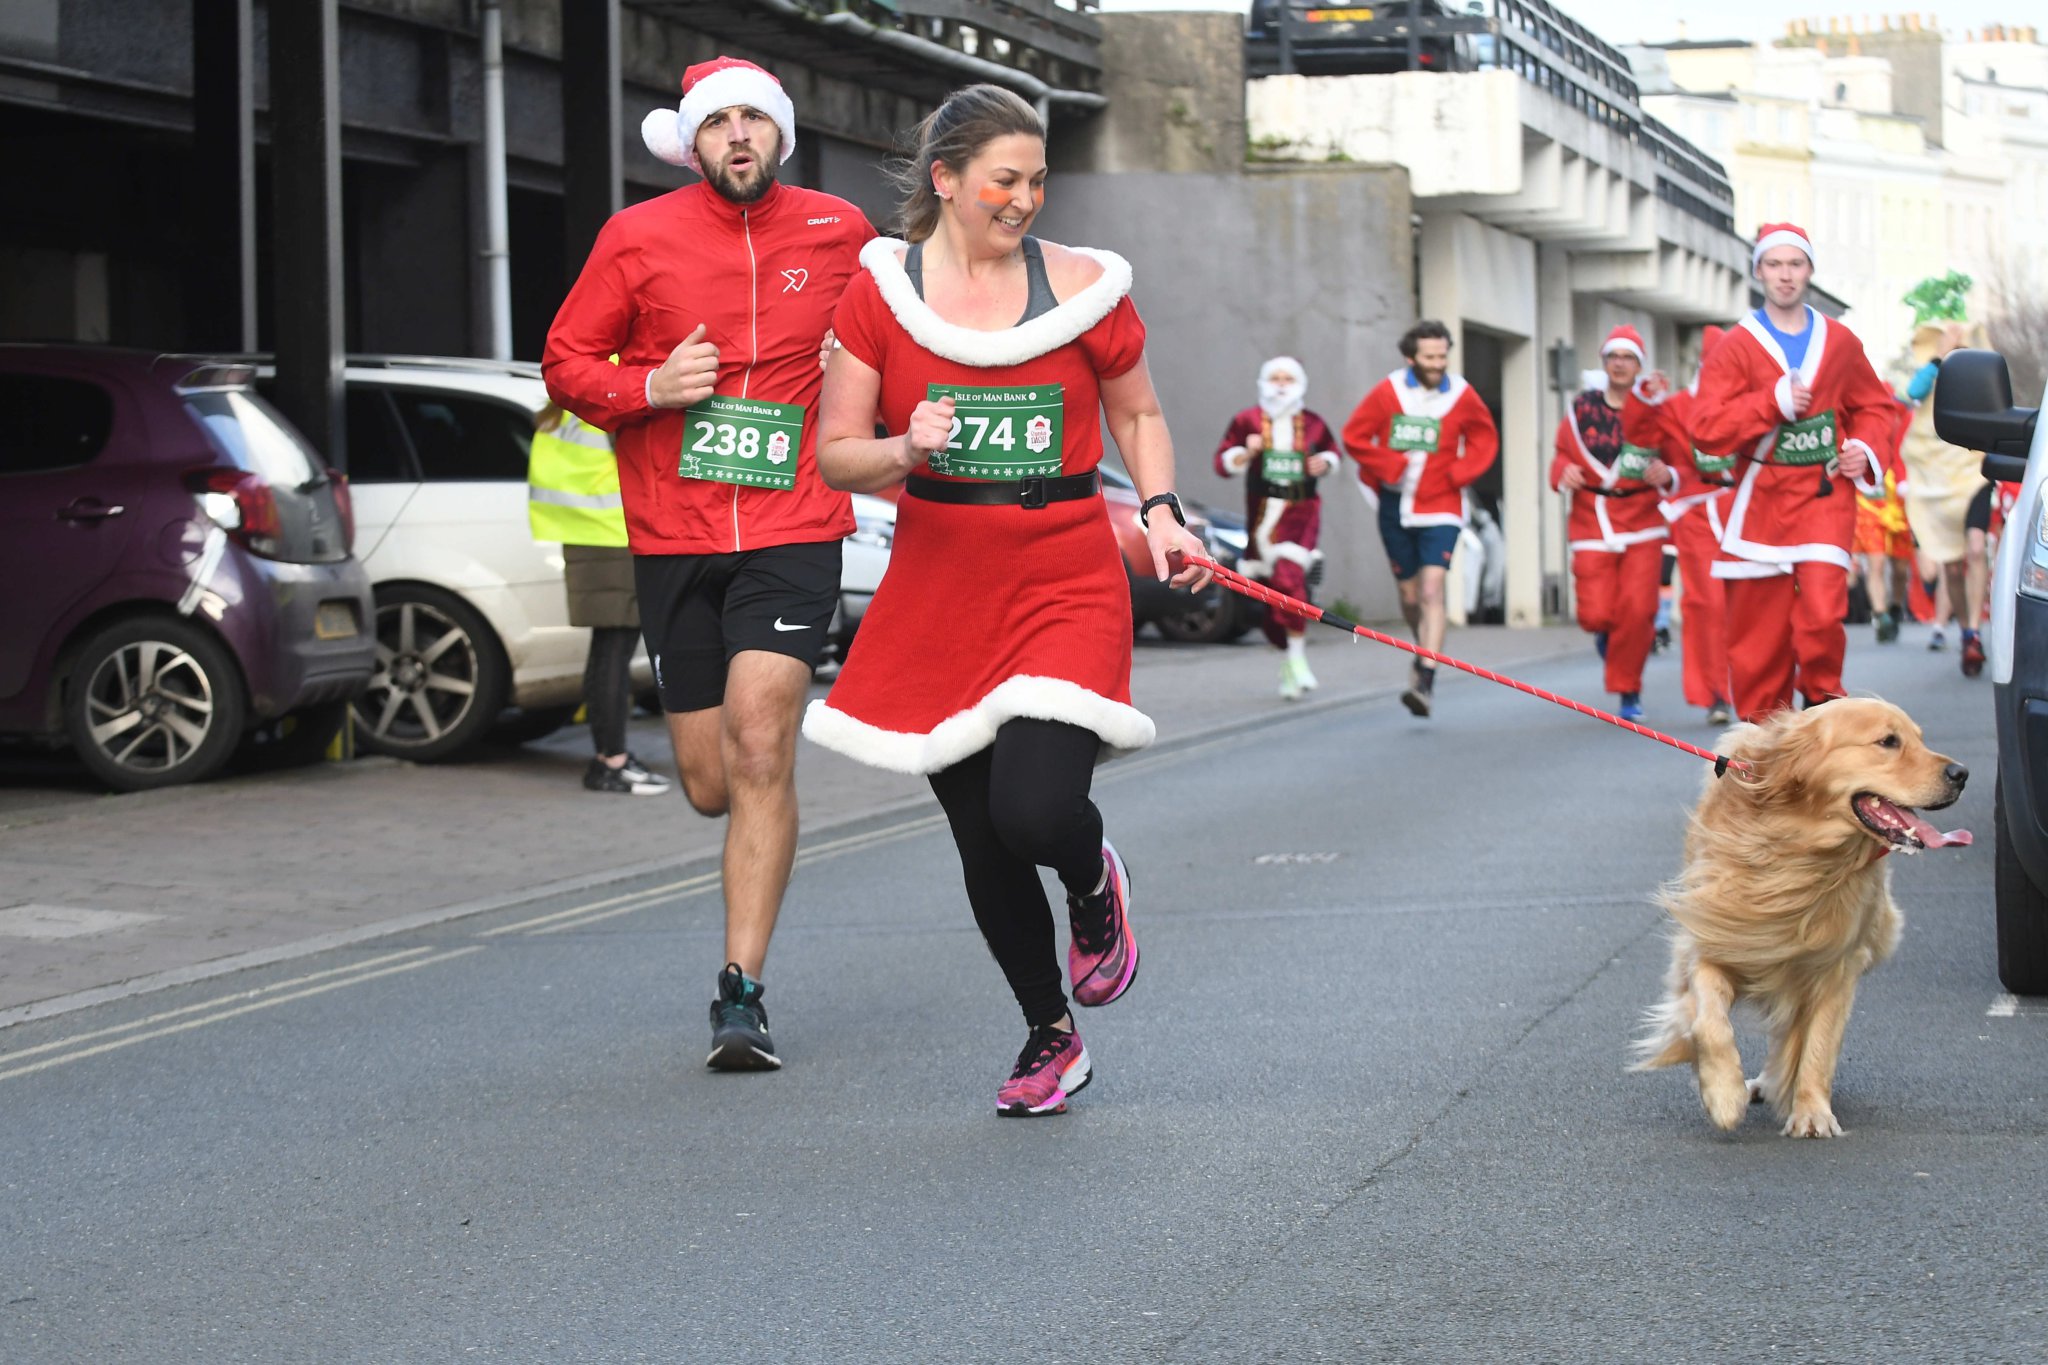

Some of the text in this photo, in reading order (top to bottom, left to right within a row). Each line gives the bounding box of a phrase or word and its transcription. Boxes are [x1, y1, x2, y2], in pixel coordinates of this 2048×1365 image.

[807, 217, 833, 225] CRAFT
[983, 393, 1002, 402] MAN
[1004, 392, 1027, 402] BANK
[735, 403, 753, 413] MAN
[753, 406, 773, 416] BANK
[691, 421, 760, 459] 238
[948, 416, 1016, 451] 274
[1781, 430, 1819, 451] 206
